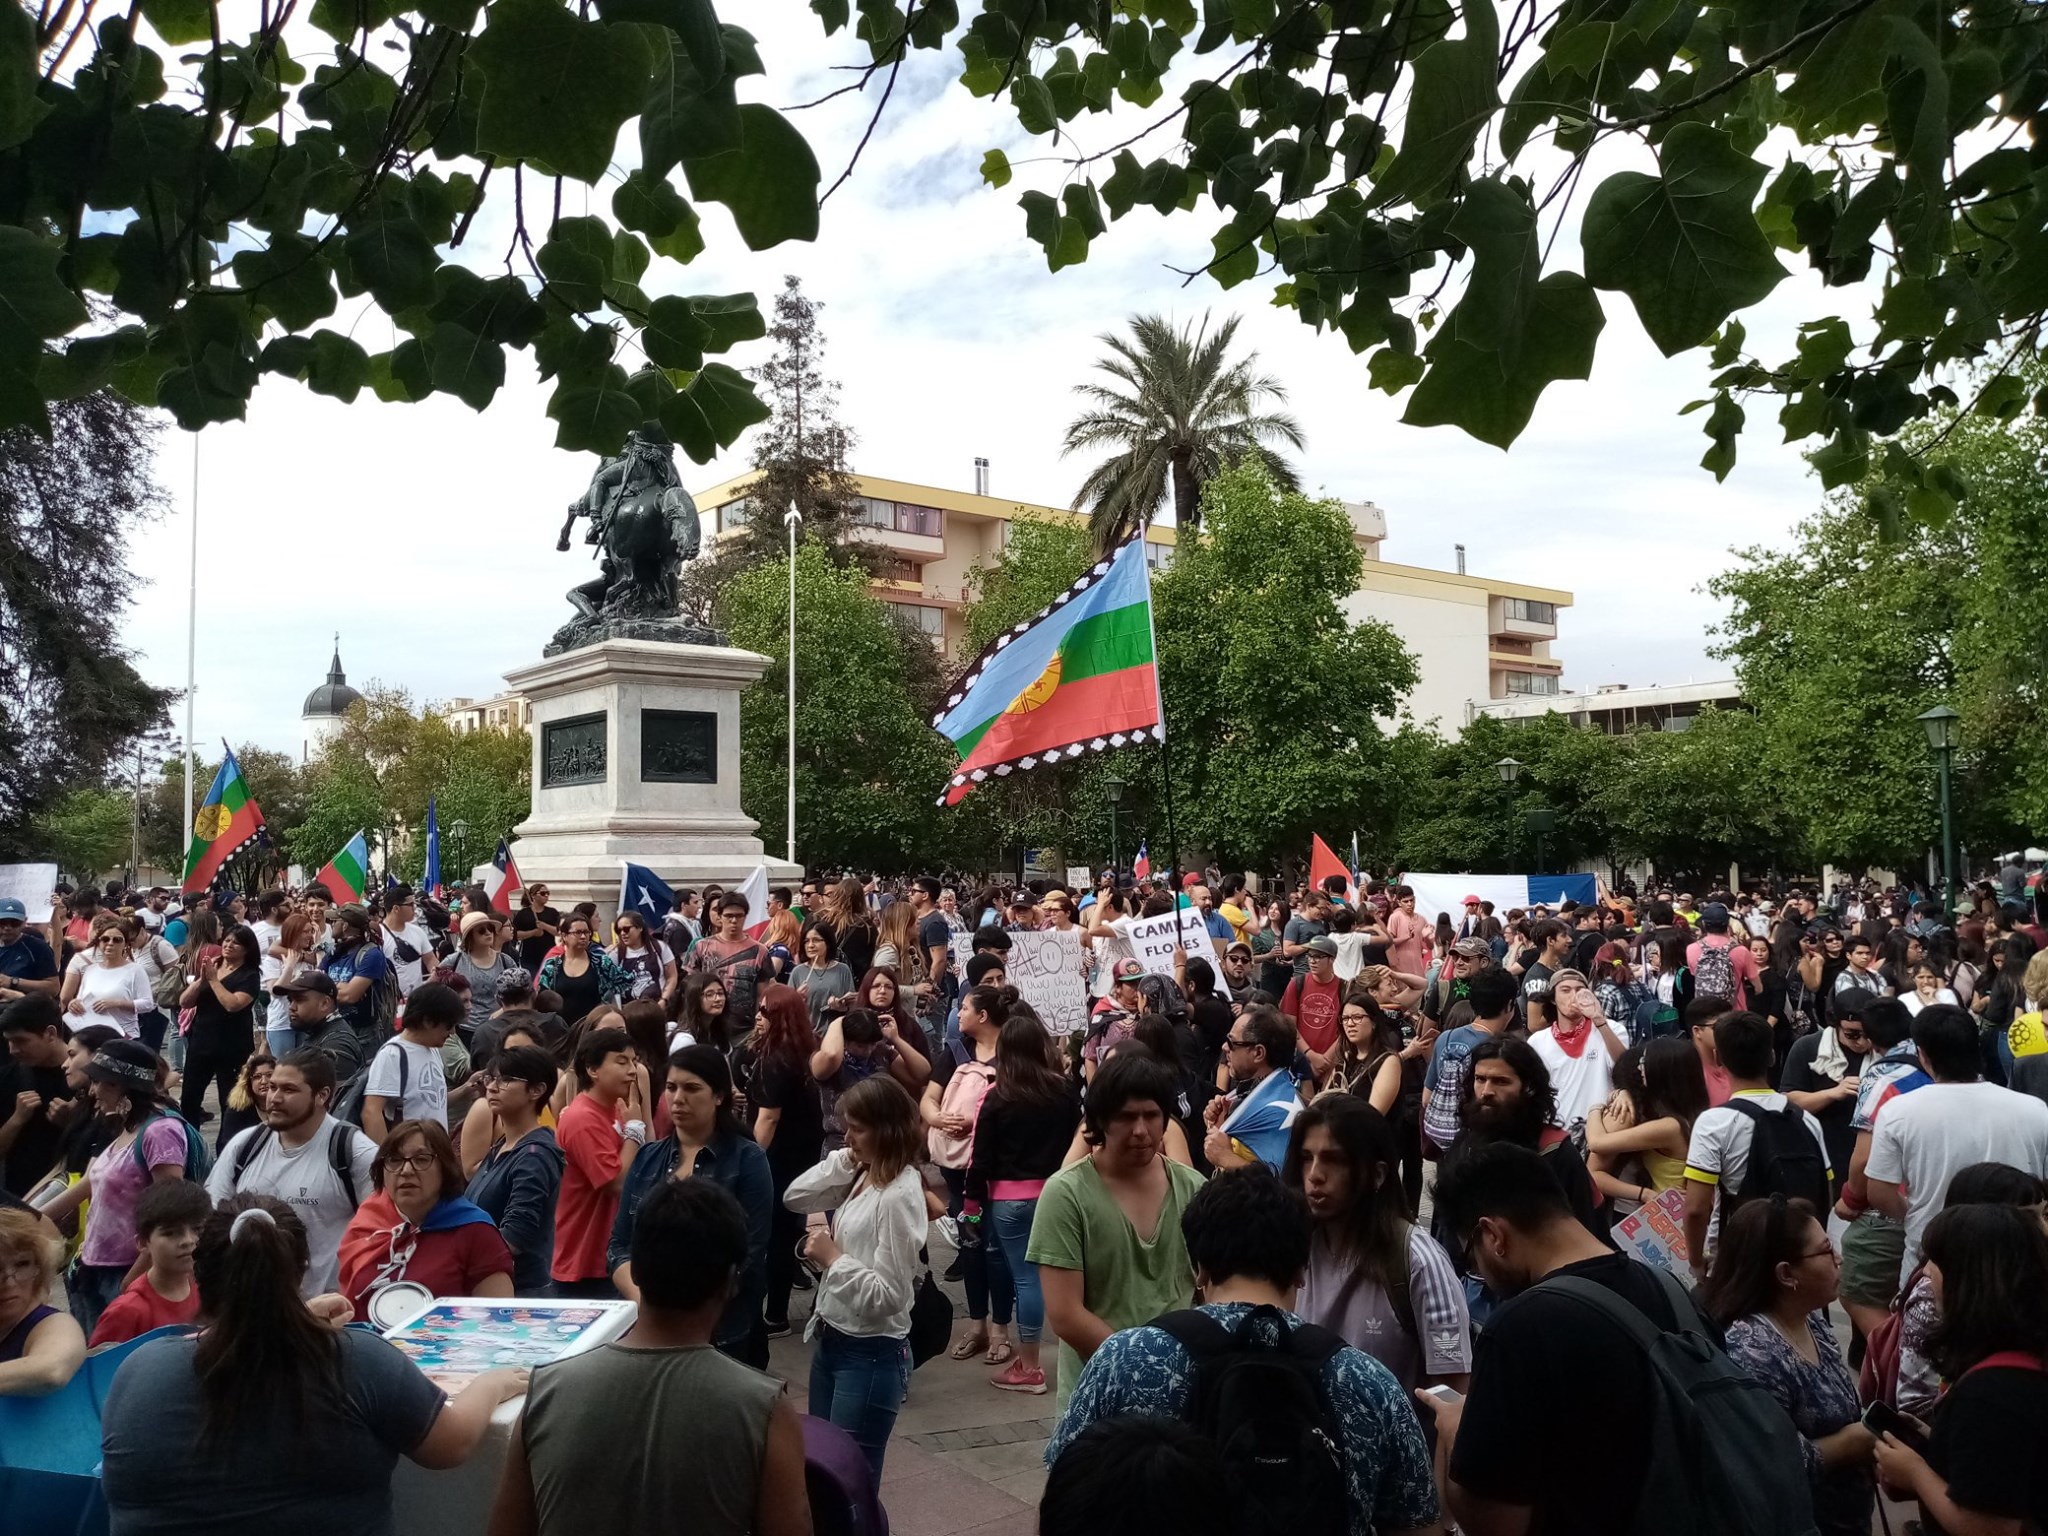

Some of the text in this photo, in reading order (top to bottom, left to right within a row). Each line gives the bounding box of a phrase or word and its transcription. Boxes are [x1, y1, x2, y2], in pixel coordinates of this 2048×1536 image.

[1133, 916, 1203, 939] CAMILA
[1145, 938, 1200, 957] FLOES
[1619, 1215, 1642, 1241] EL
[1434, 1350, 1463, 1359] adidas
